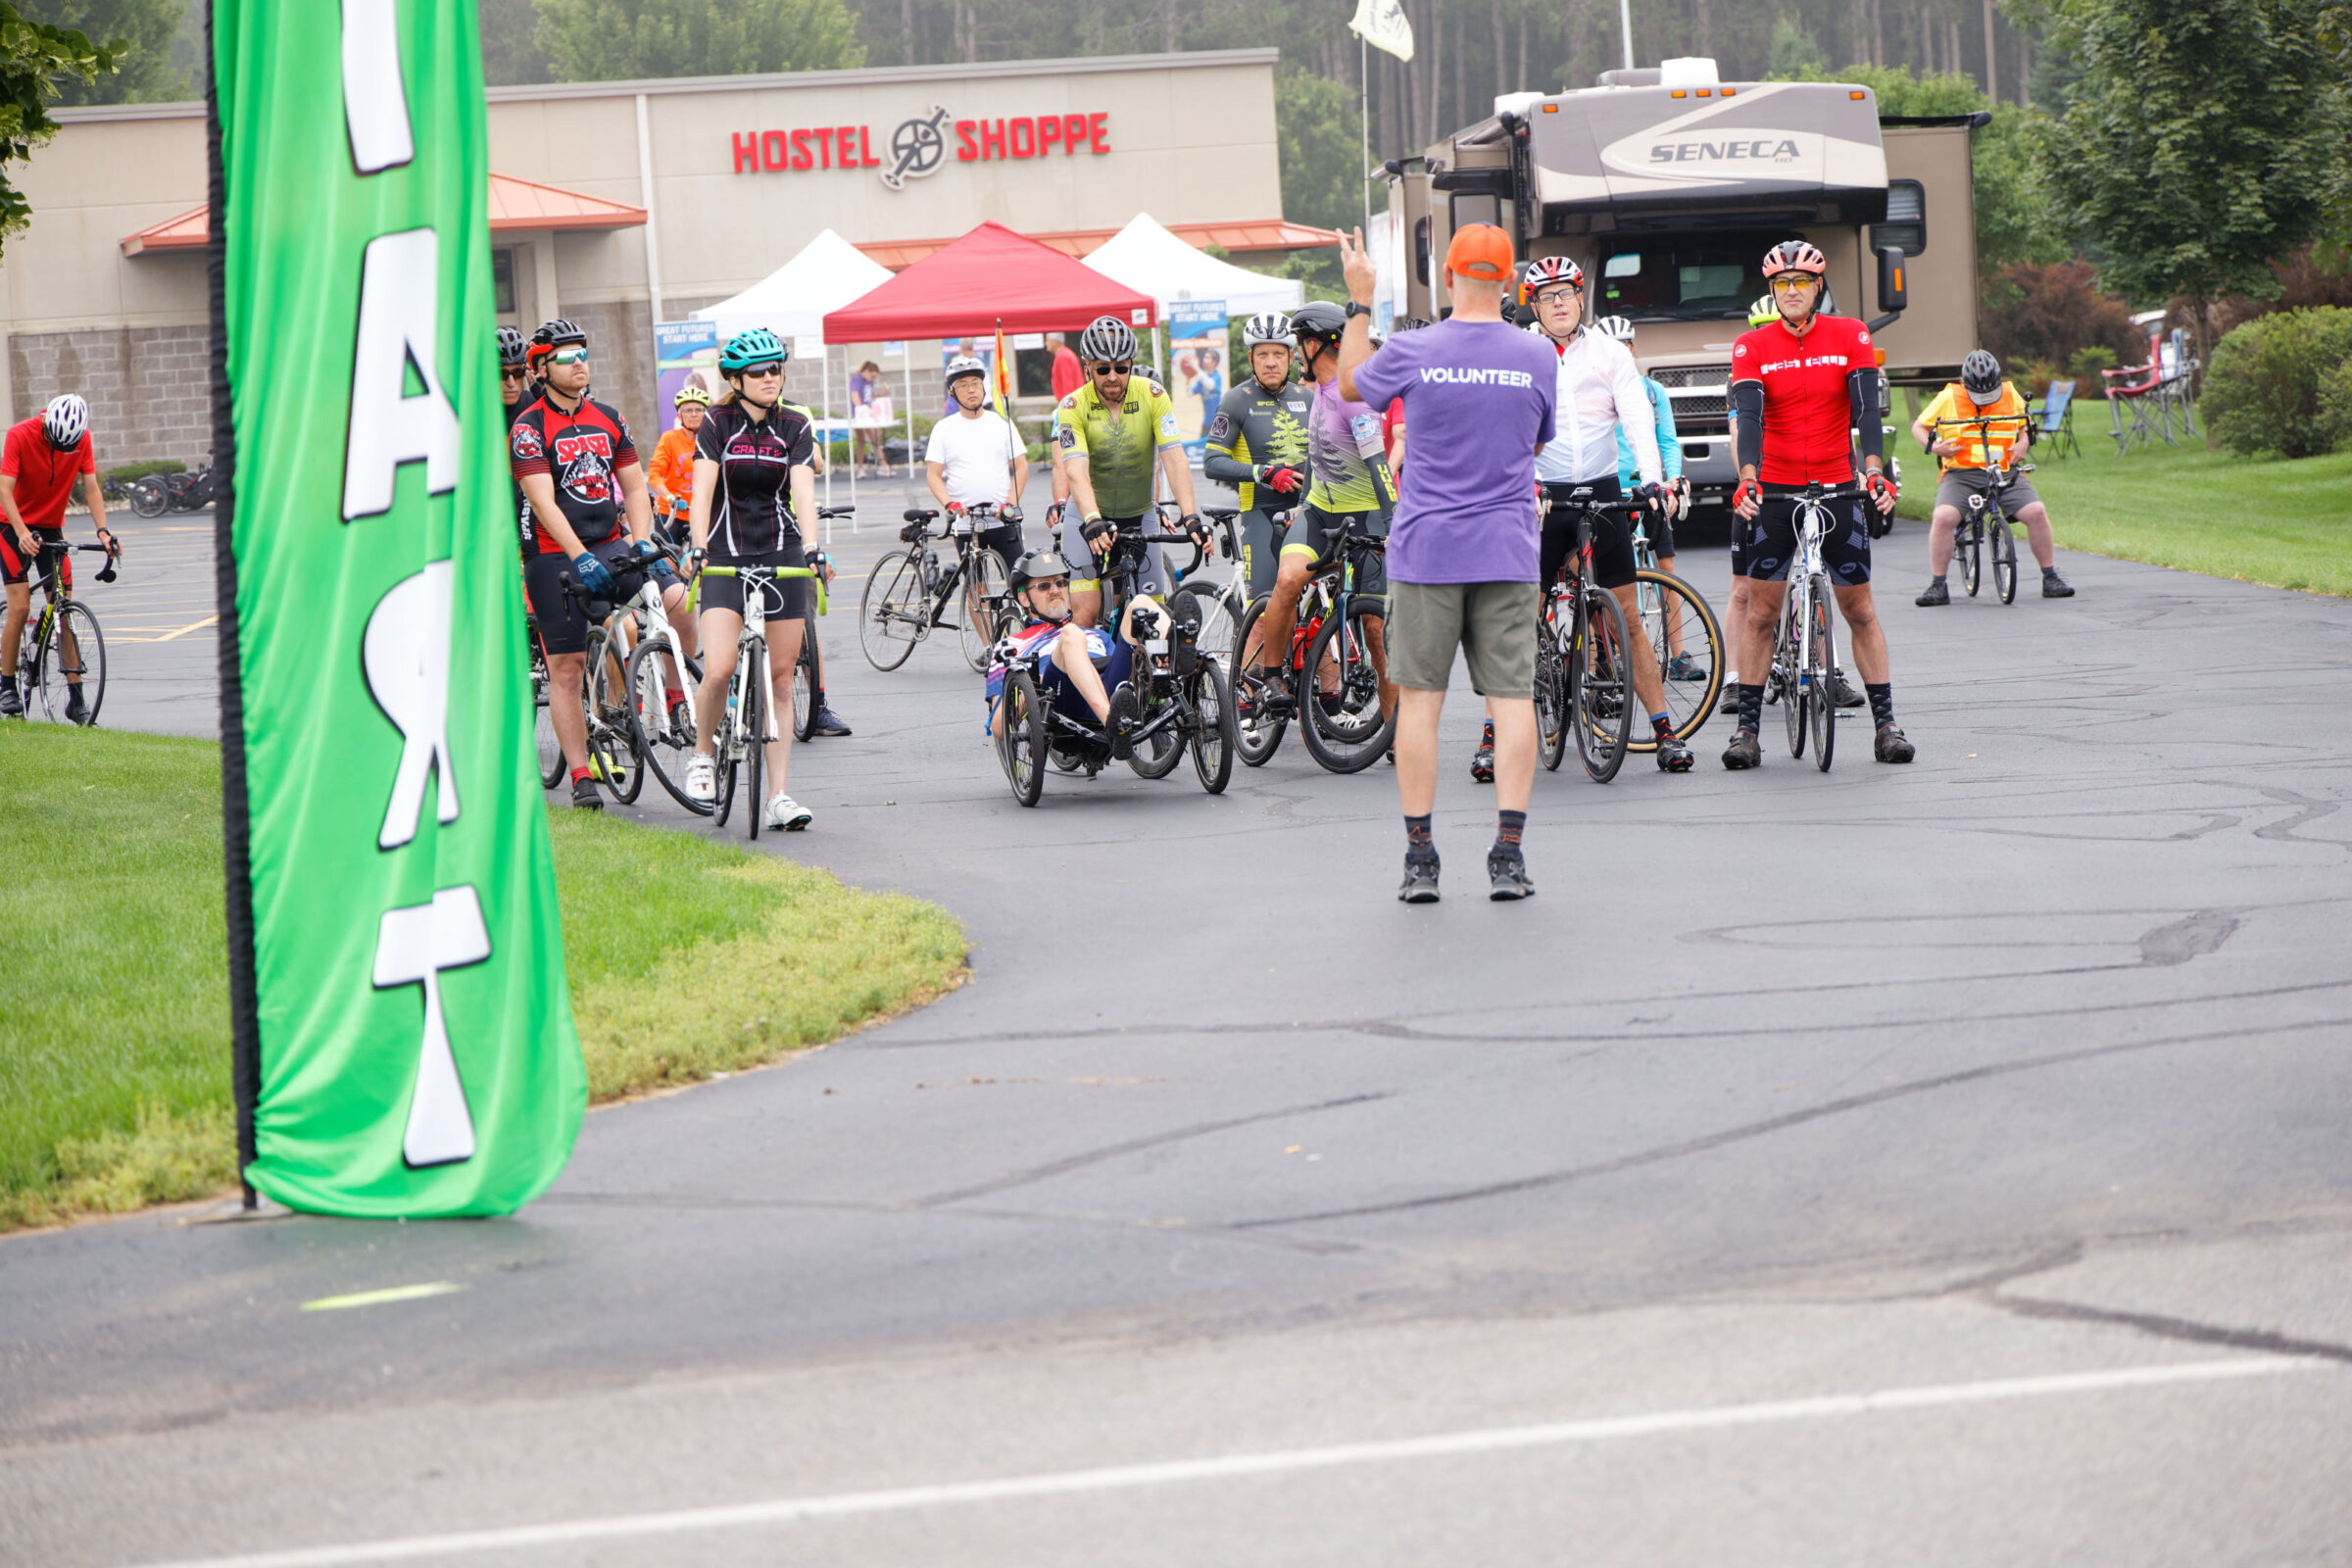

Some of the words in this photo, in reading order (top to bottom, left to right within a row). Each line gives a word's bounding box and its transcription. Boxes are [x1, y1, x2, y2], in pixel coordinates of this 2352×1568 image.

[732, 125, 880, 173] HOSTEL
[956, 112, 1110, 162] SHOPPE
[1649, 140, 1800, 163] SENECA
[1420, 368, 1532, 388] VOLUNTEER
[557, 434, 612, 464] SPASH
[731, 444, 772, 456] CRAFT
